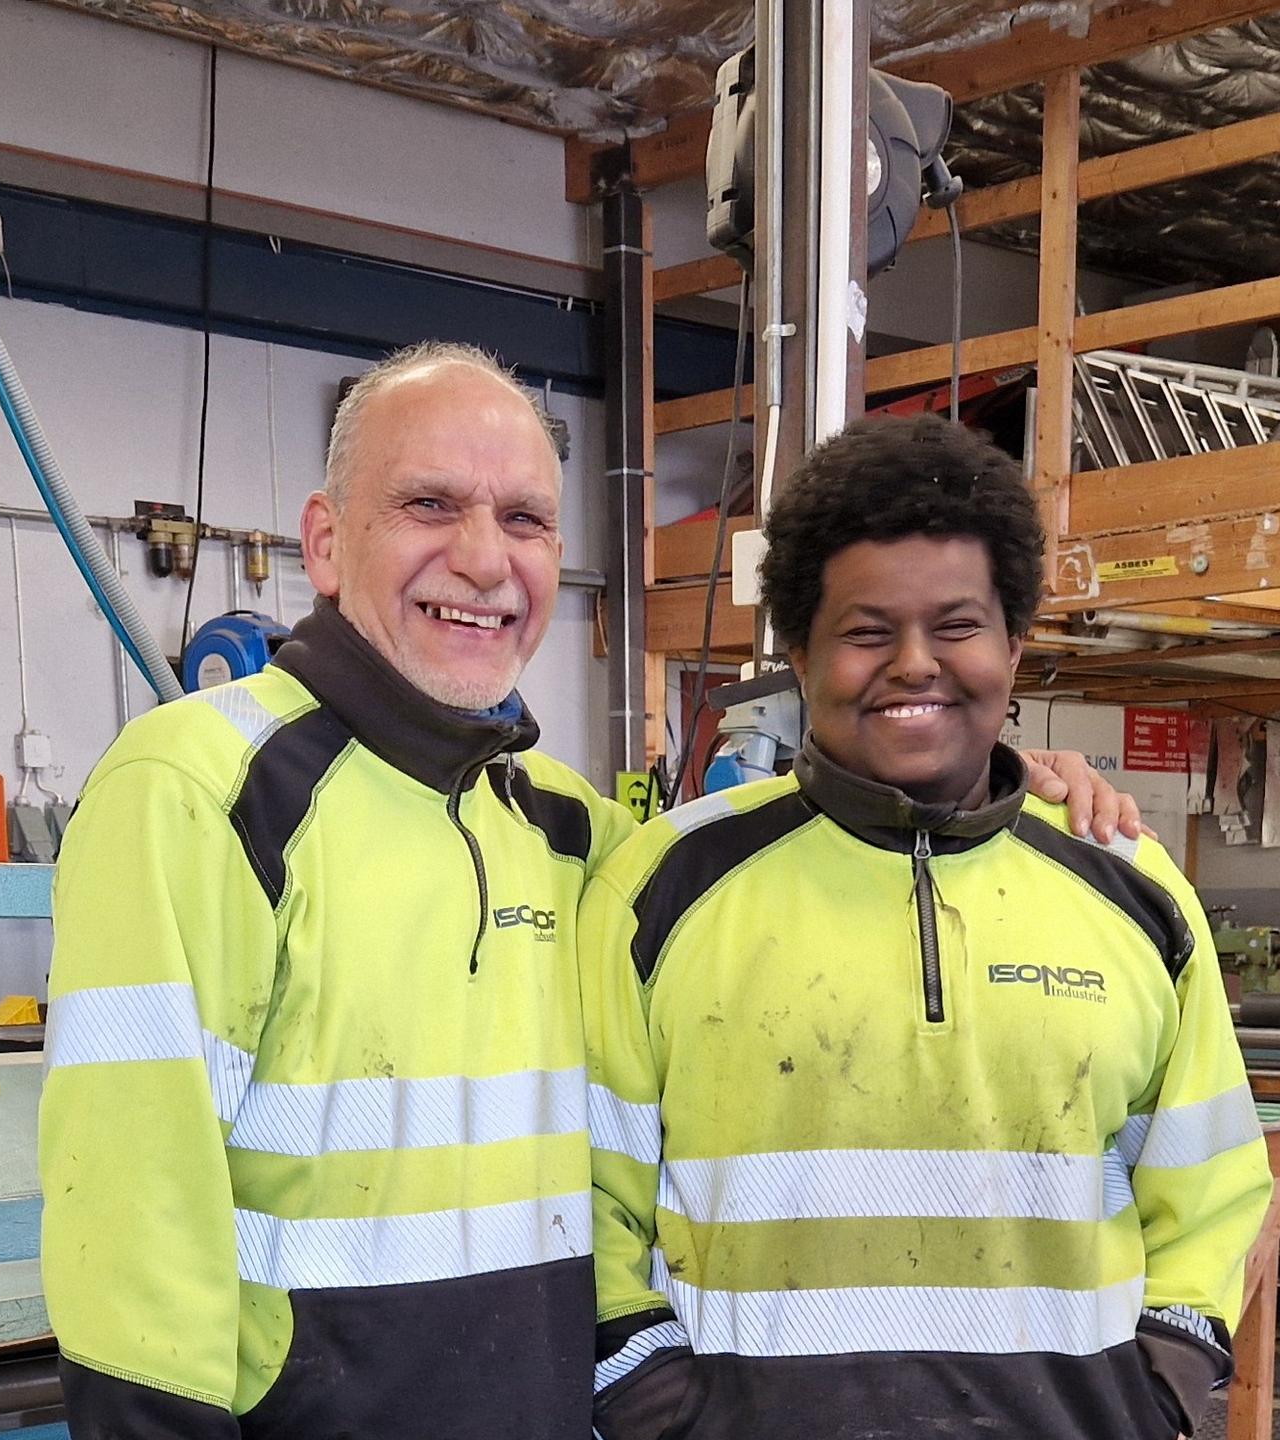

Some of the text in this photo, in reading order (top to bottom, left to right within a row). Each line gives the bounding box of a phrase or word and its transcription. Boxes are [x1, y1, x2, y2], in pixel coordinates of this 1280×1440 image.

[1114, 559, 1155, 570] ASBEST
[988, 964, 1106, 997] ISONOR
[1051, 985, 1108, 1005] Industrier
